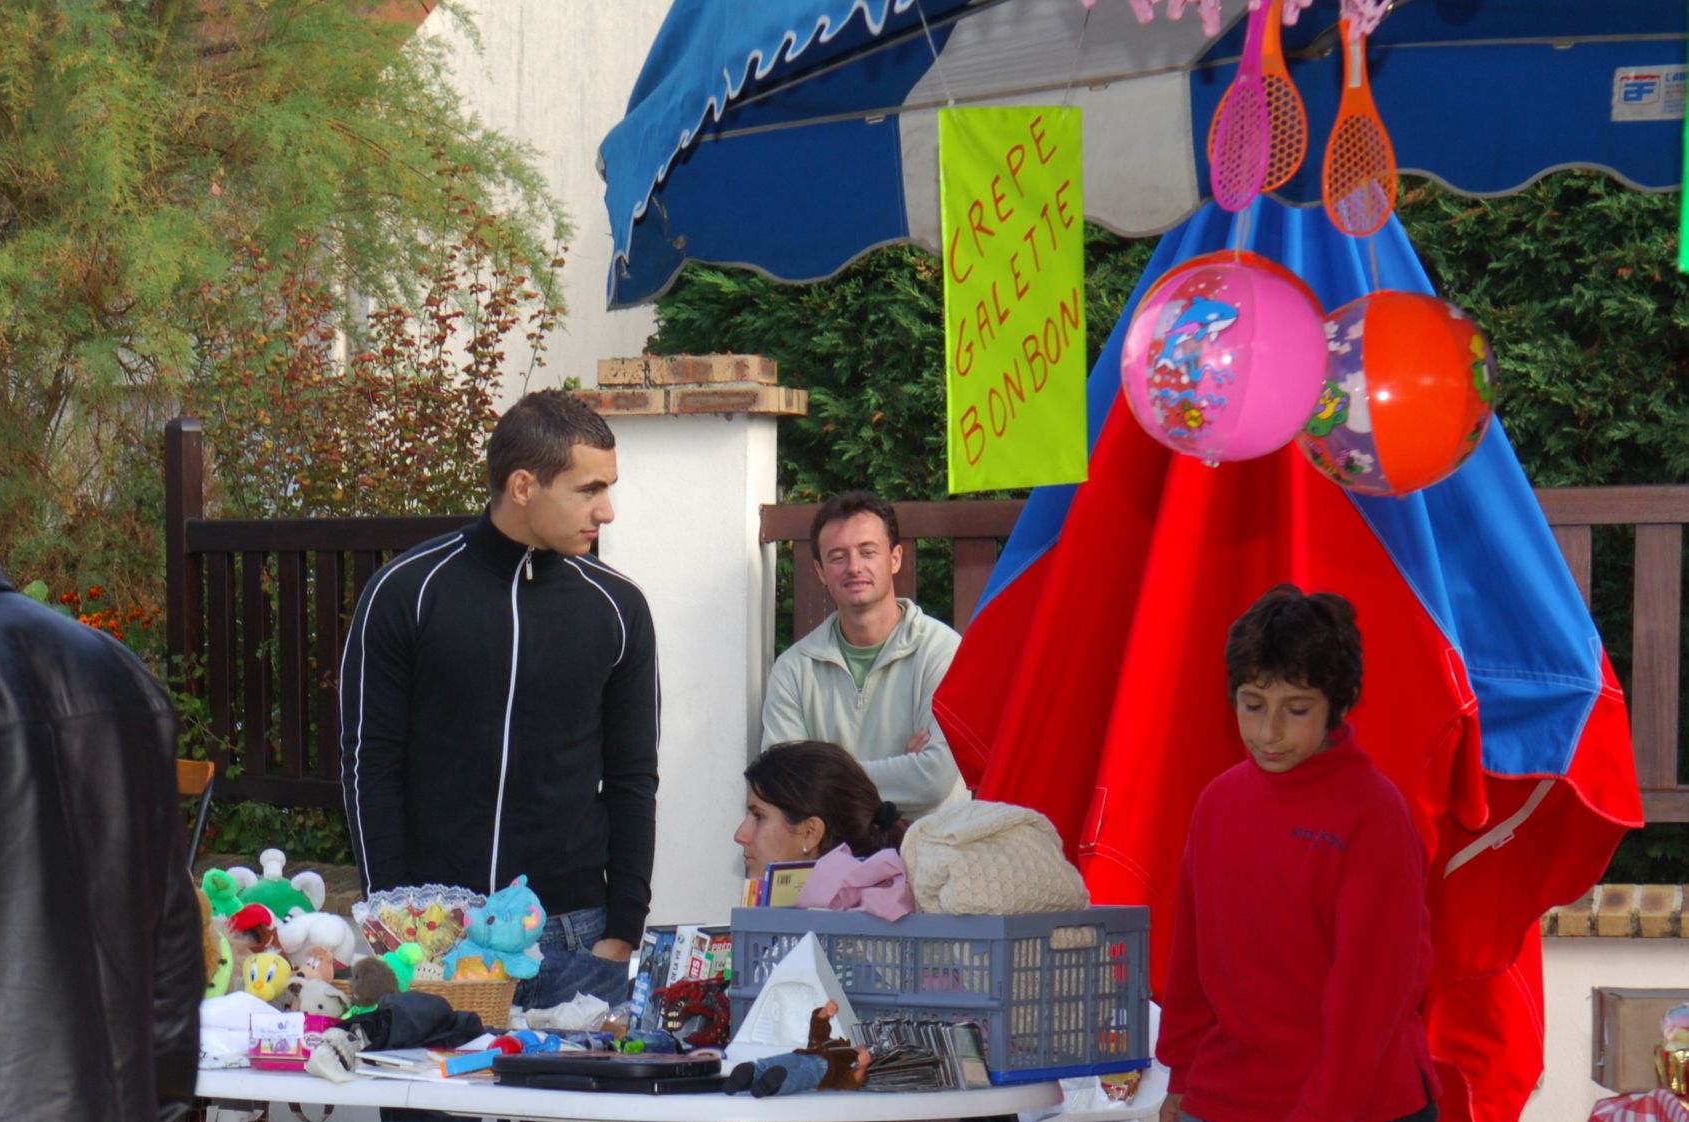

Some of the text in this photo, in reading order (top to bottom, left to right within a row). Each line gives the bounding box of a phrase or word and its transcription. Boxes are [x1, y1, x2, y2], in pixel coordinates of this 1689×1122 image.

[949, 114, 1058, 285] CREPE
[955, 179, 1074, 378] GALETTE
[959, 287, 1081, 468] BONBON
